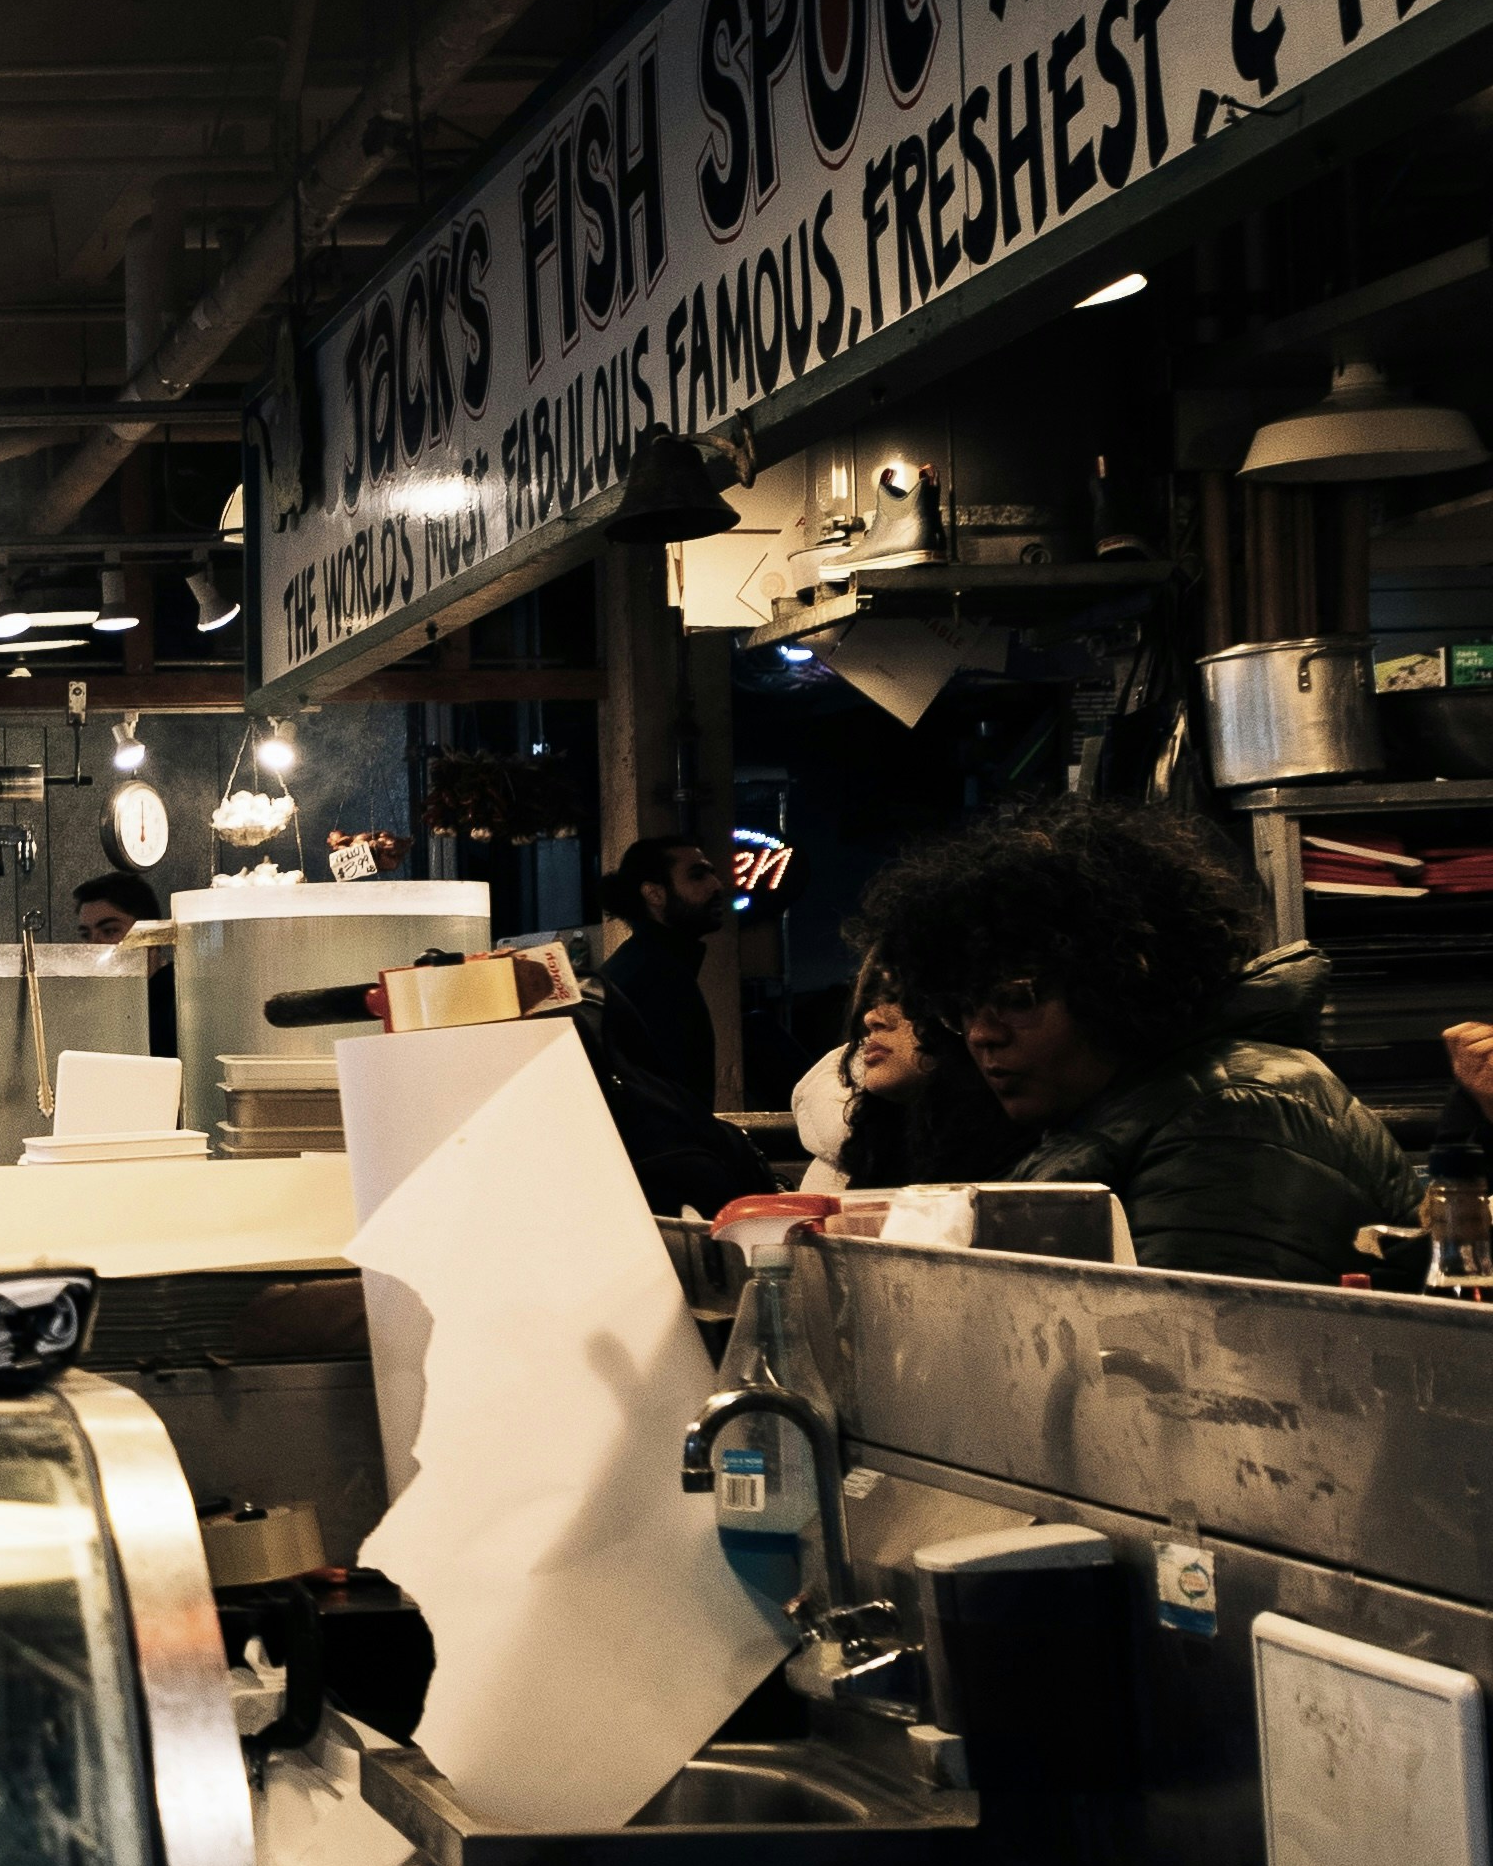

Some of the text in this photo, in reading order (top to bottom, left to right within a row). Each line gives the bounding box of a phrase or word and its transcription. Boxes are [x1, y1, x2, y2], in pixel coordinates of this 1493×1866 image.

[519, 21, 668, 385] FISH
[283, 561, 317, 665] THE
[323, 505, 415, 643] WORLD'S
